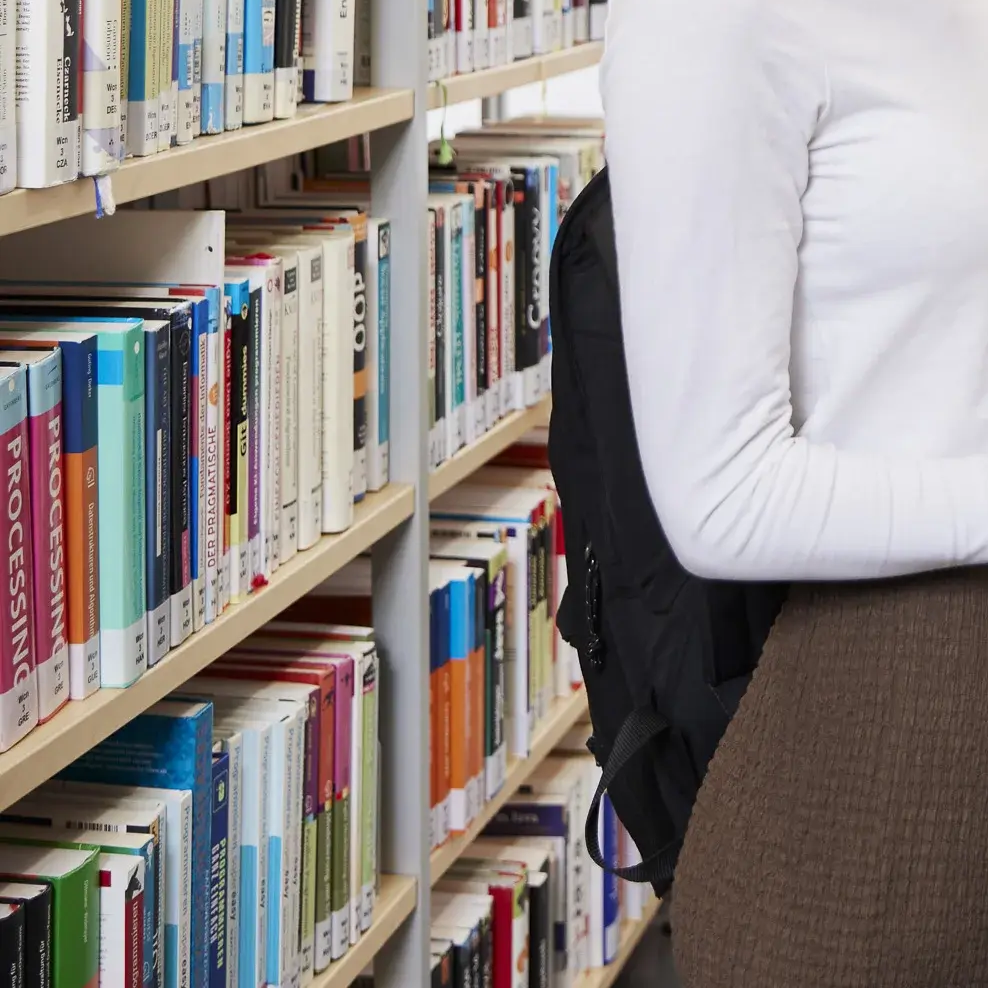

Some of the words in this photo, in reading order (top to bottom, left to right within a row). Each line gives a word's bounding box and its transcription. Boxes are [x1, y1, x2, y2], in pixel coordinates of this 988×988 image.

[56, 159, 68, 169] CZA
[207, 426, 217, 536] PRAGMATISCHE
[207, 539, 216, 568] DER
[211, 843, 219, 880] GANZ
[216, 837, 226, 968] PROGRAMMIEREN
